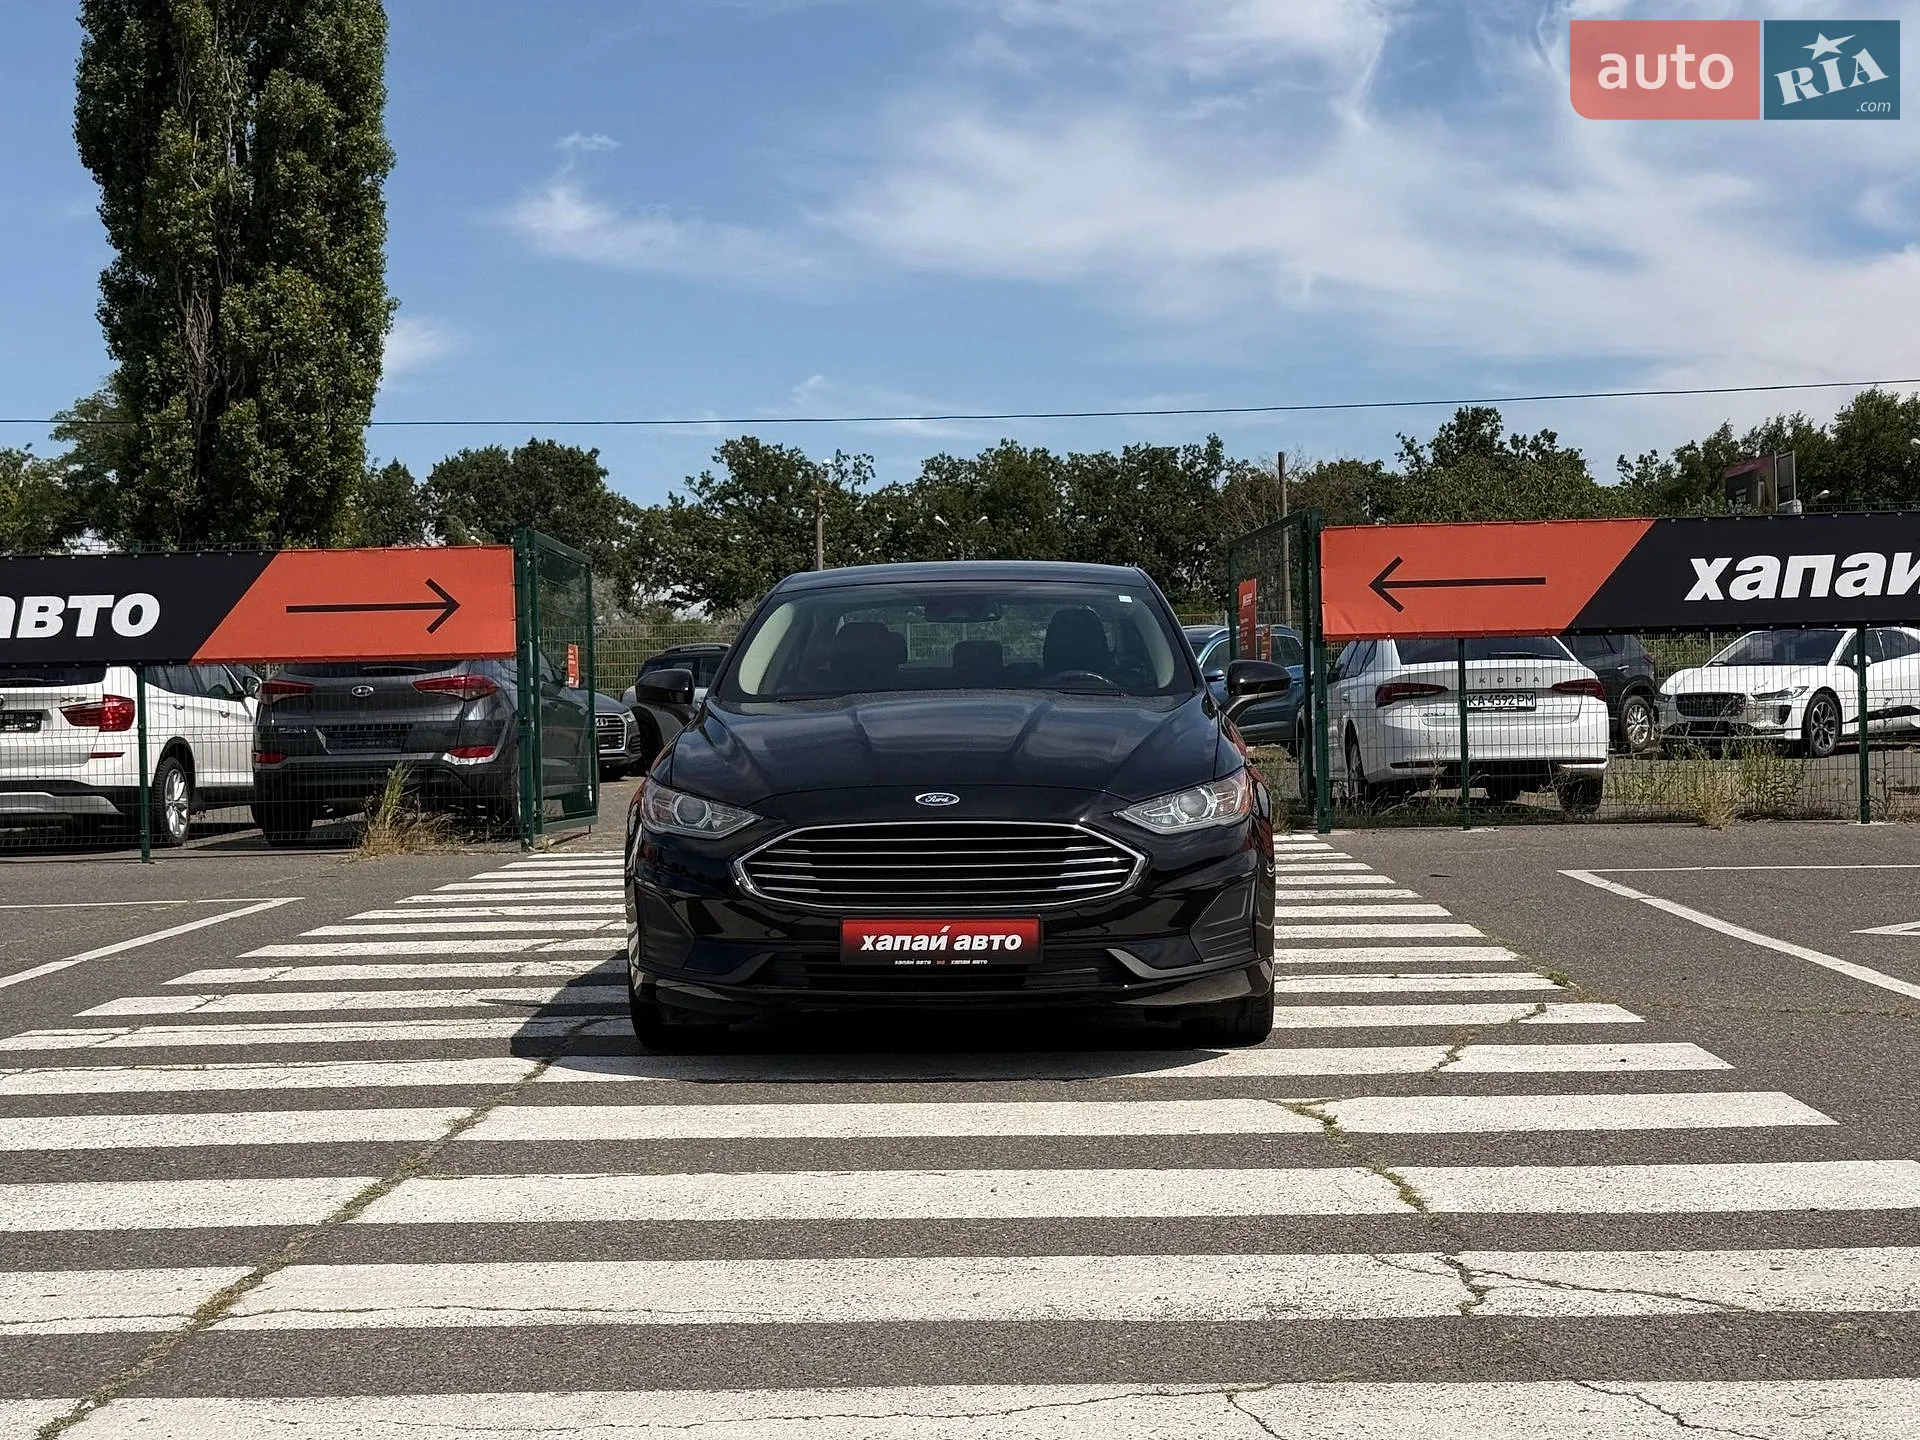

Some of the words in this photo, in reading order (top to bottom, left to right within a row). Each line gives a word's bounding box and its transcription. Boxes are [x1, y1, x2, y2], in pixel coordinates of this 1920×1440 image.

[1479, 676, 1540, 684] KODA
[860, 925, 952, 951] хапай
[953, 934, 1023, 951] авто
